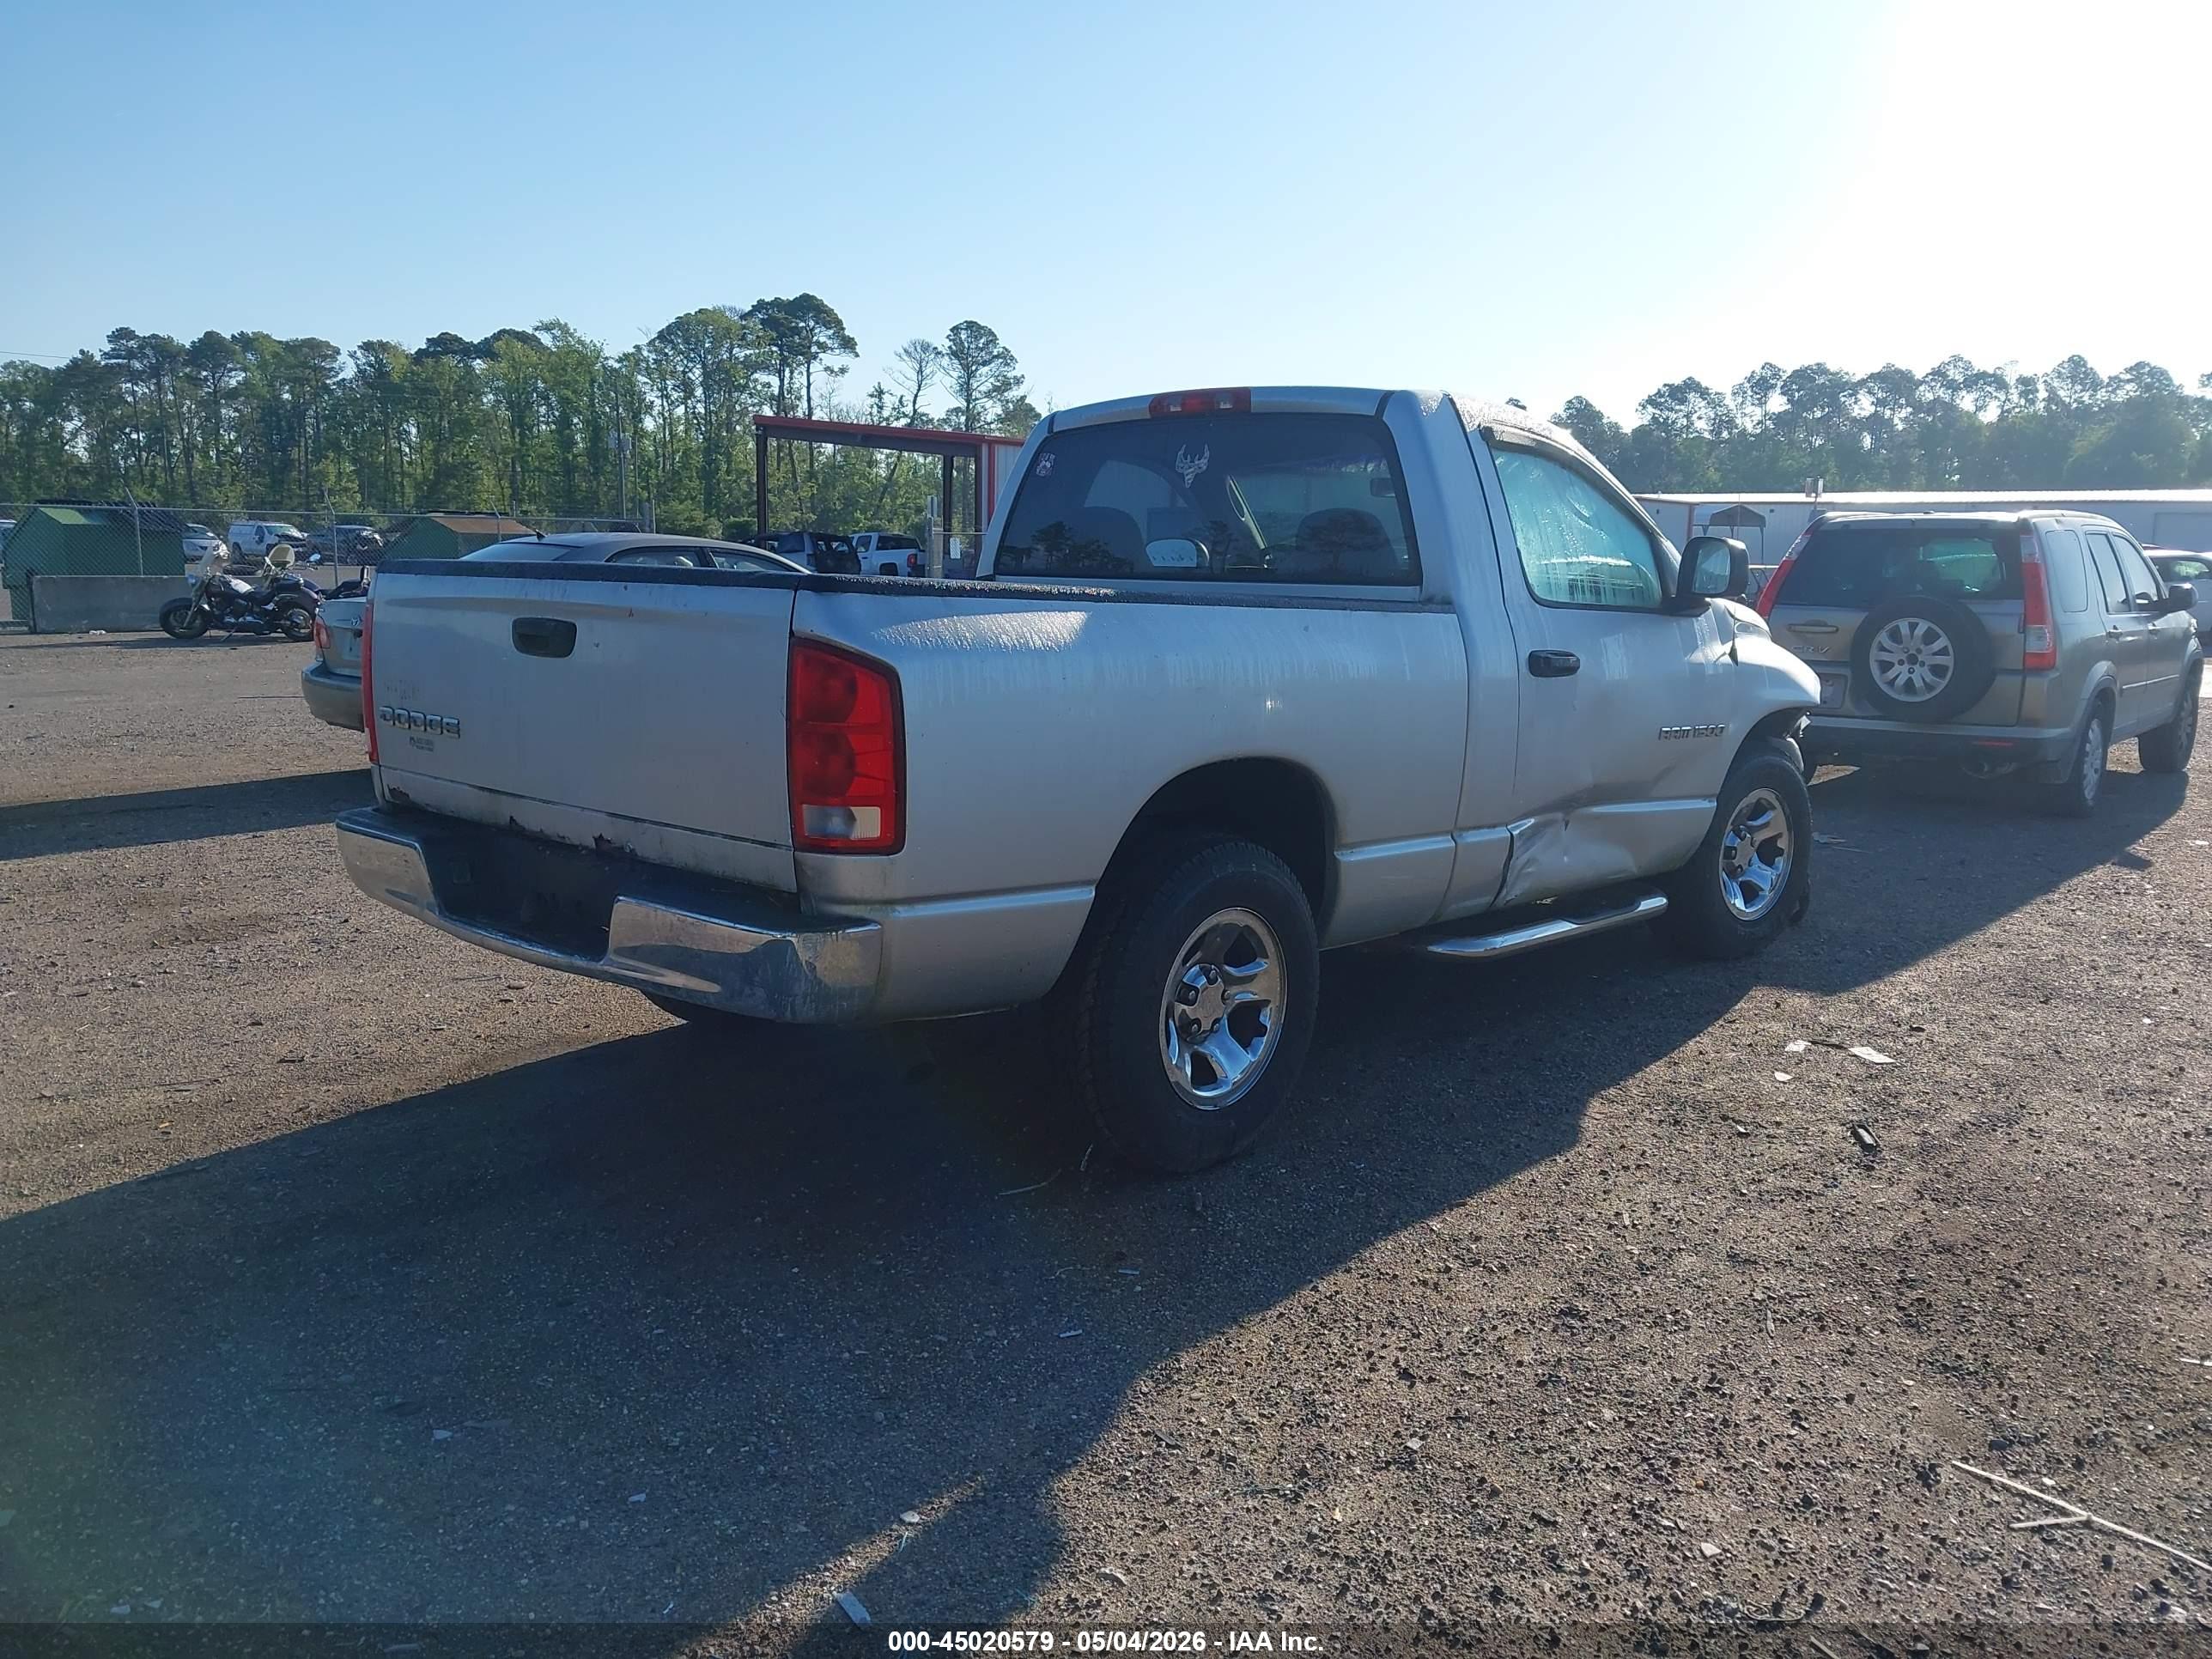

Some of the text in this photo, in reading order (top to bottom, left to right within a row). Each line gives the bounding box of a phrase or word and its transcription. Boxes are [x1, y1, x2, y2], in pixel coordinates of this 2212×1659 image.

[379, 705, 461, 739] DODGE
[1658, 724, 1726, 740] RAM 1500
